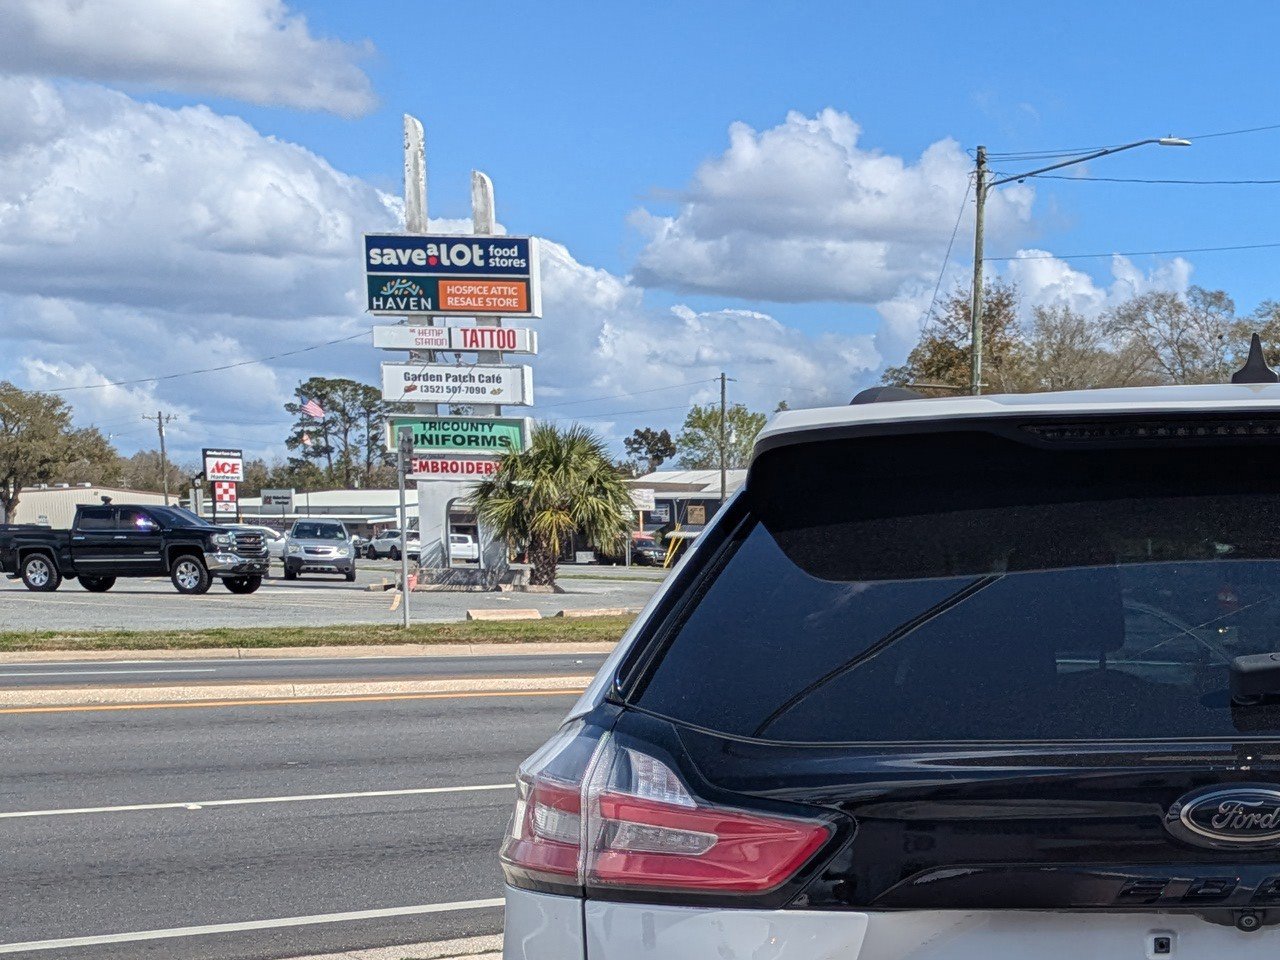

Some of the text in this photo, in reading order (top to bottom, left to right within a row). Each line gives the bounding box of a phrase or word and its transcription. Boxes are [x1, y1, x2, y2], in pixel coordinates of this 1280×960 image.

[488, 245, 518, 257] food
[488, 257, 527, 268] stores
[446, 286, 518, 296] HOSPICE ATTIC
[372, 297, 432, 310] HAVEN
[447, 297, 518, 308] RESALE STORE
[415, 337, 447, 346] STATION
[460, 328, 517, 349] TATTOO
[403, 371, 502, 384] Garden Patch Café
[420, 384, 444, 393] (352)
[420, 421, 495, 433] TRICOUNTY
[210, 460, 240, 474] ACE
[1211, 800, 1280, 829] Ford
